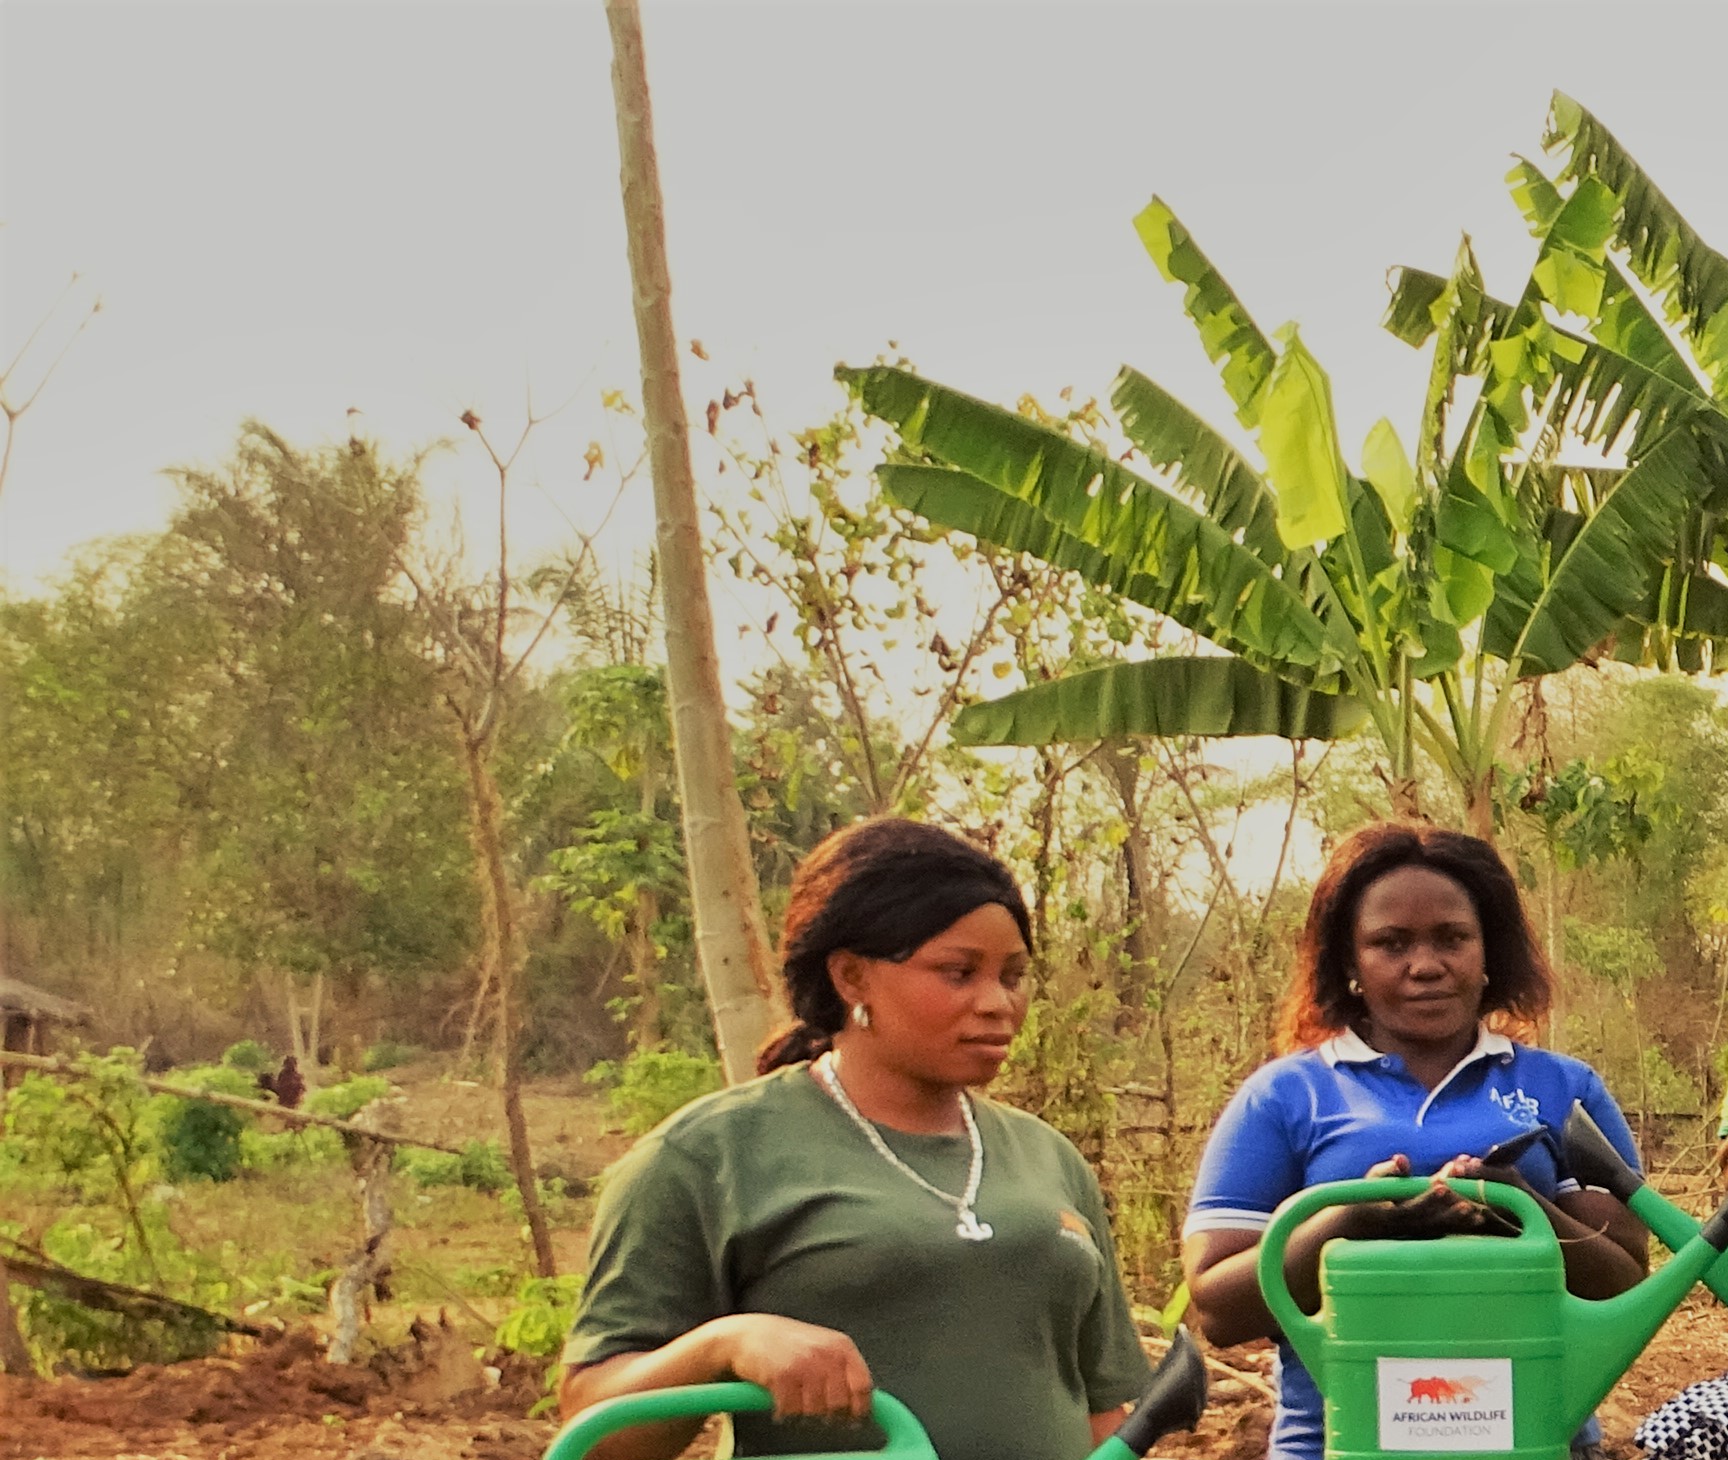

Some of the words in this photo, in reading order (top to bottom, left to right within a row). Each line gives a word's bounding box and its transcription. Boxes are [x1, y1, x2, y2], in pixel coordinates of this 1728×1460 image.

[1392, 1412, 1446, 1422] AFRICAN
[1450, 1410, 1507, 1421] WILDLIFE
[1408, 1425, 1492, 1437] FOUNDATION
